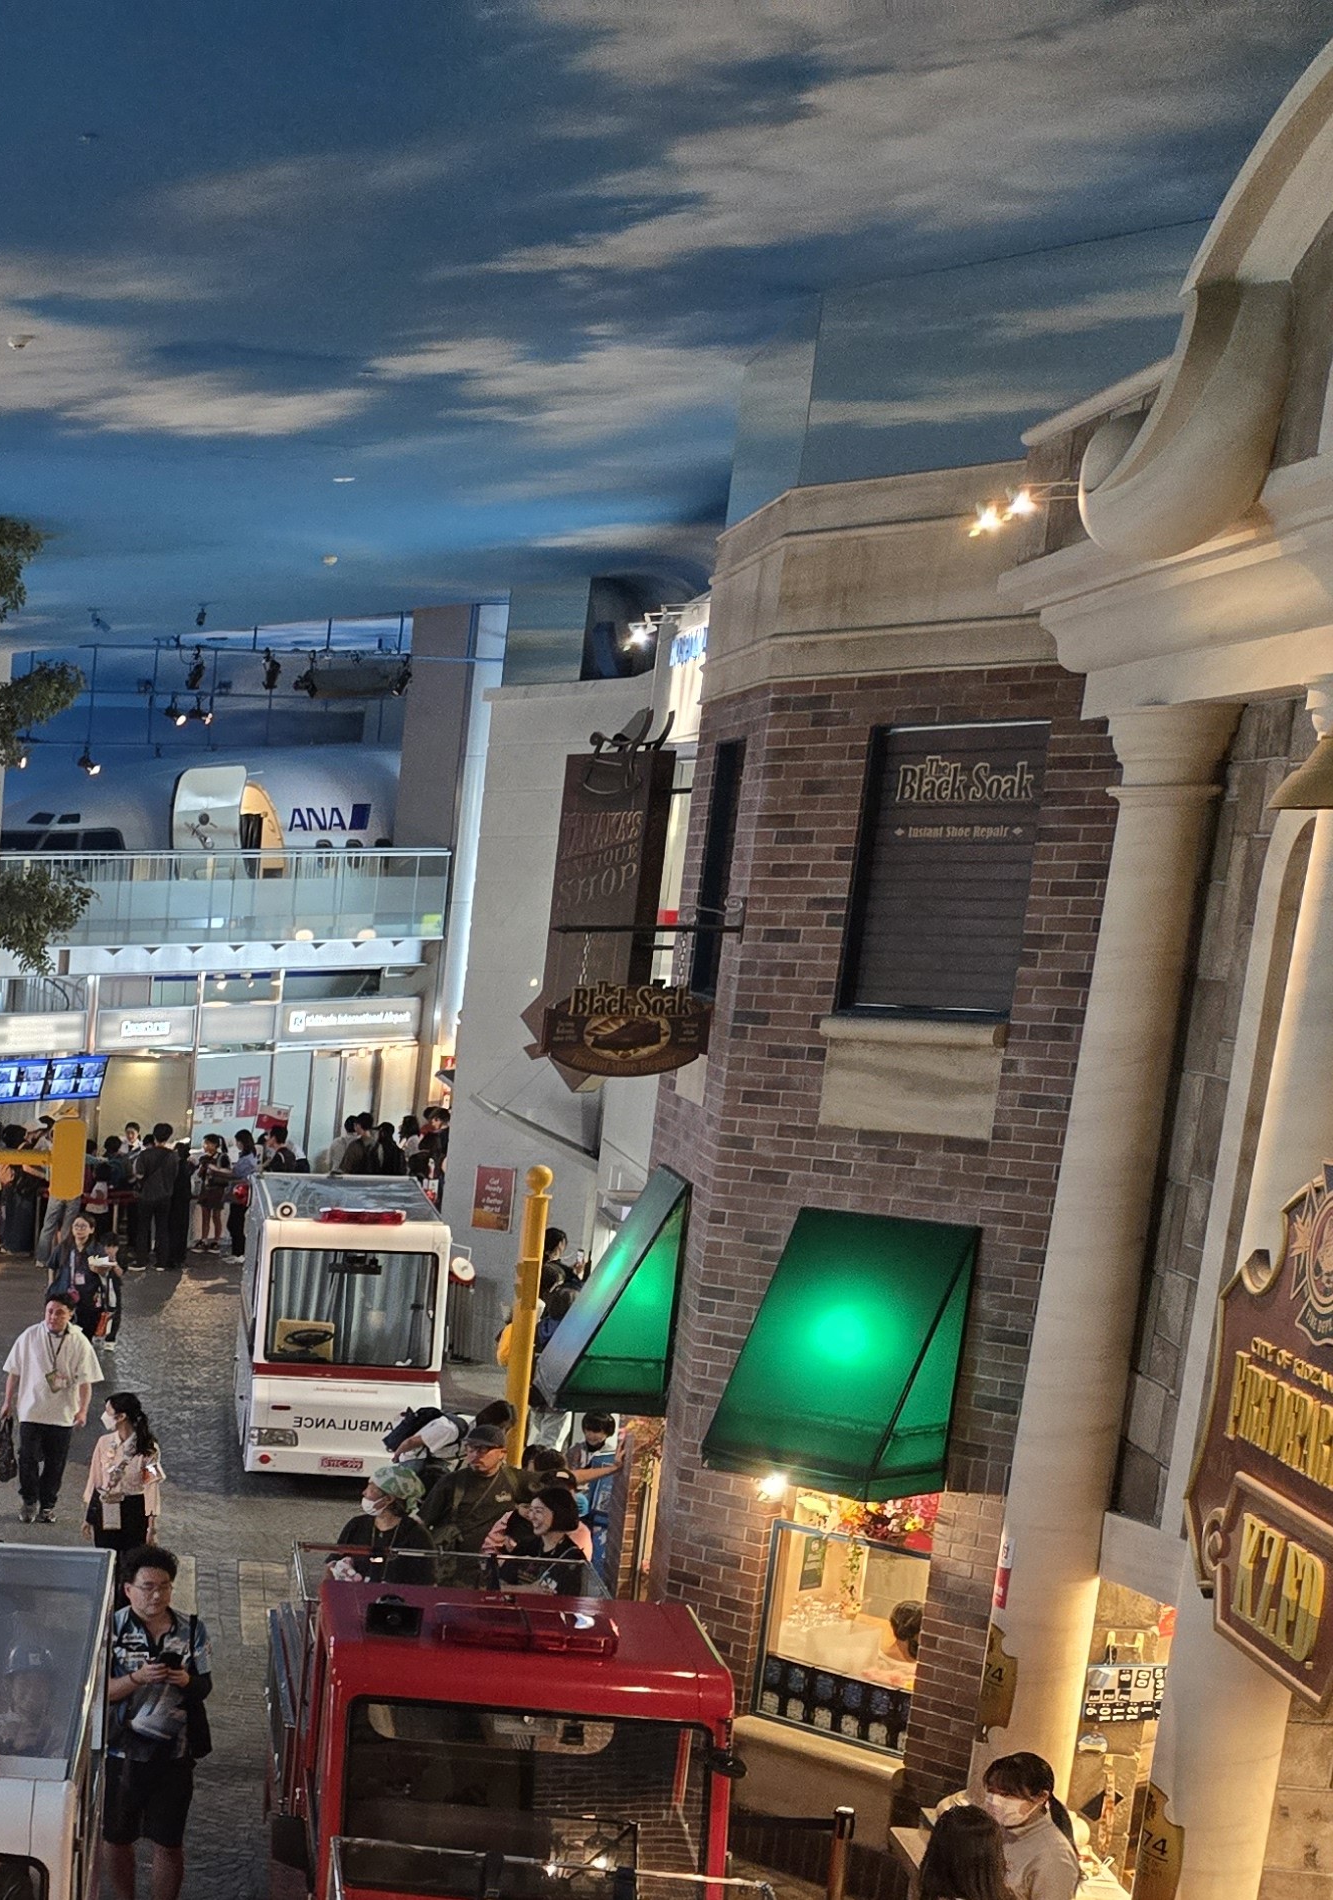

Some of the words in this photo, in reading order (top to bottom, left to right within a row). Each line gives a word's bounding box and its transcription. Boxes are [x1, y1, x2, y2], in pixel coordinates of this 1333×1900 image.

[895, 763, 967, 802] Black
[969, 761, 1034, 801] Soak
[926, 755, 951, 776] The
[288, 807, 347, 831] ANA
[908, 826, 943, 839] Instant
[946, 825, 970, 838] Shoe
[973, 825, 1009, 839] Repair
[559, 862, 638, 905] SHOP
[568, 986, 632, 1017] Black
[634, 984, 693, 1017] Soak
[597, 979, 618, 995] The
[1251, 1337, 1277, 1362] CITY
[1276, 1349, 1293, 1370] OF
[1224, 1350, 1278, 1450] FIRE
